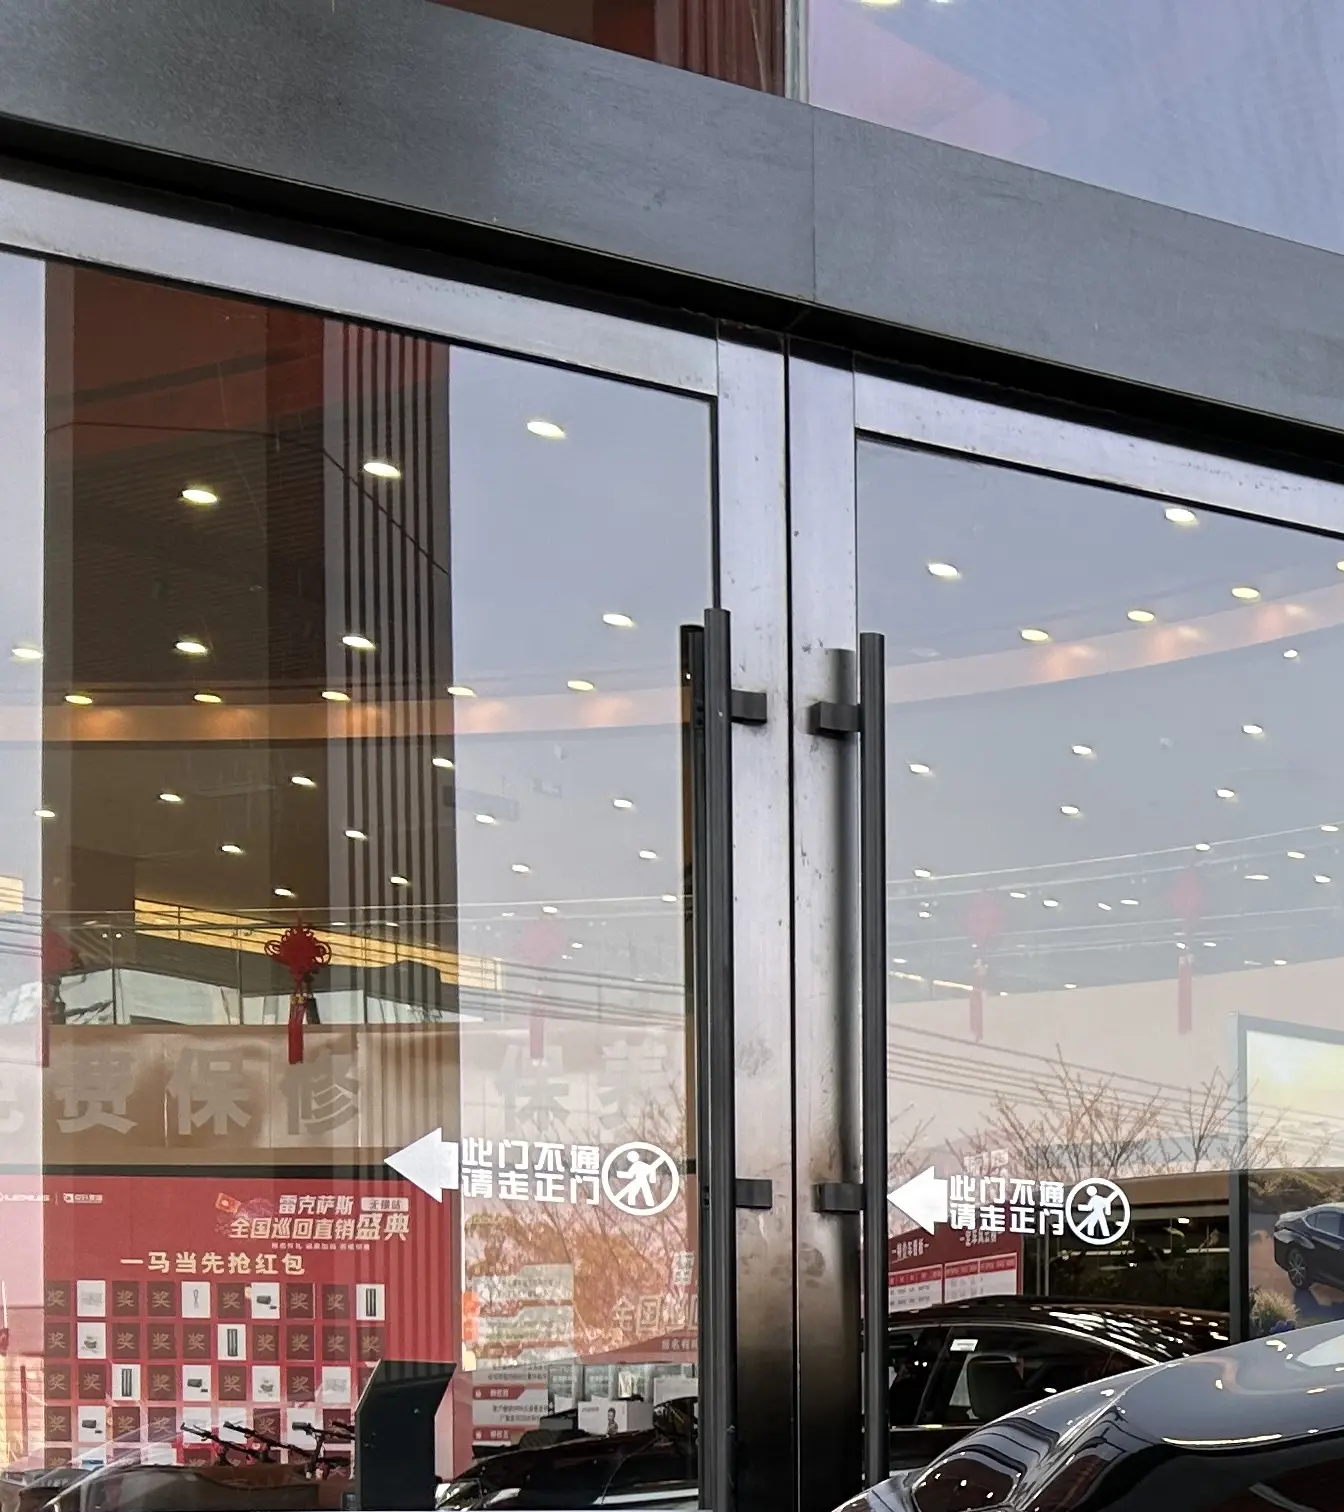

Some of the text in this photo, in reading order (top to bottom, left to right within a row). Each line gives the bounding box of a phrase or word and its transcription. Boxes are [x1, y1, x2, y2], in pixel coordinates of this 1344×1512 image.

[461, 1135, 601, 1173] 此门不通
[461, 1168, 601, 1206] 请走正门
[949, 1174, 1065, 1205] 此门不通
[278, 1194, 355, 1216] 雷克萨斯
[949, 1201, 1065, 1237] 请走正门
[120, 1251, 305, 1276] 一马当先抢红包
